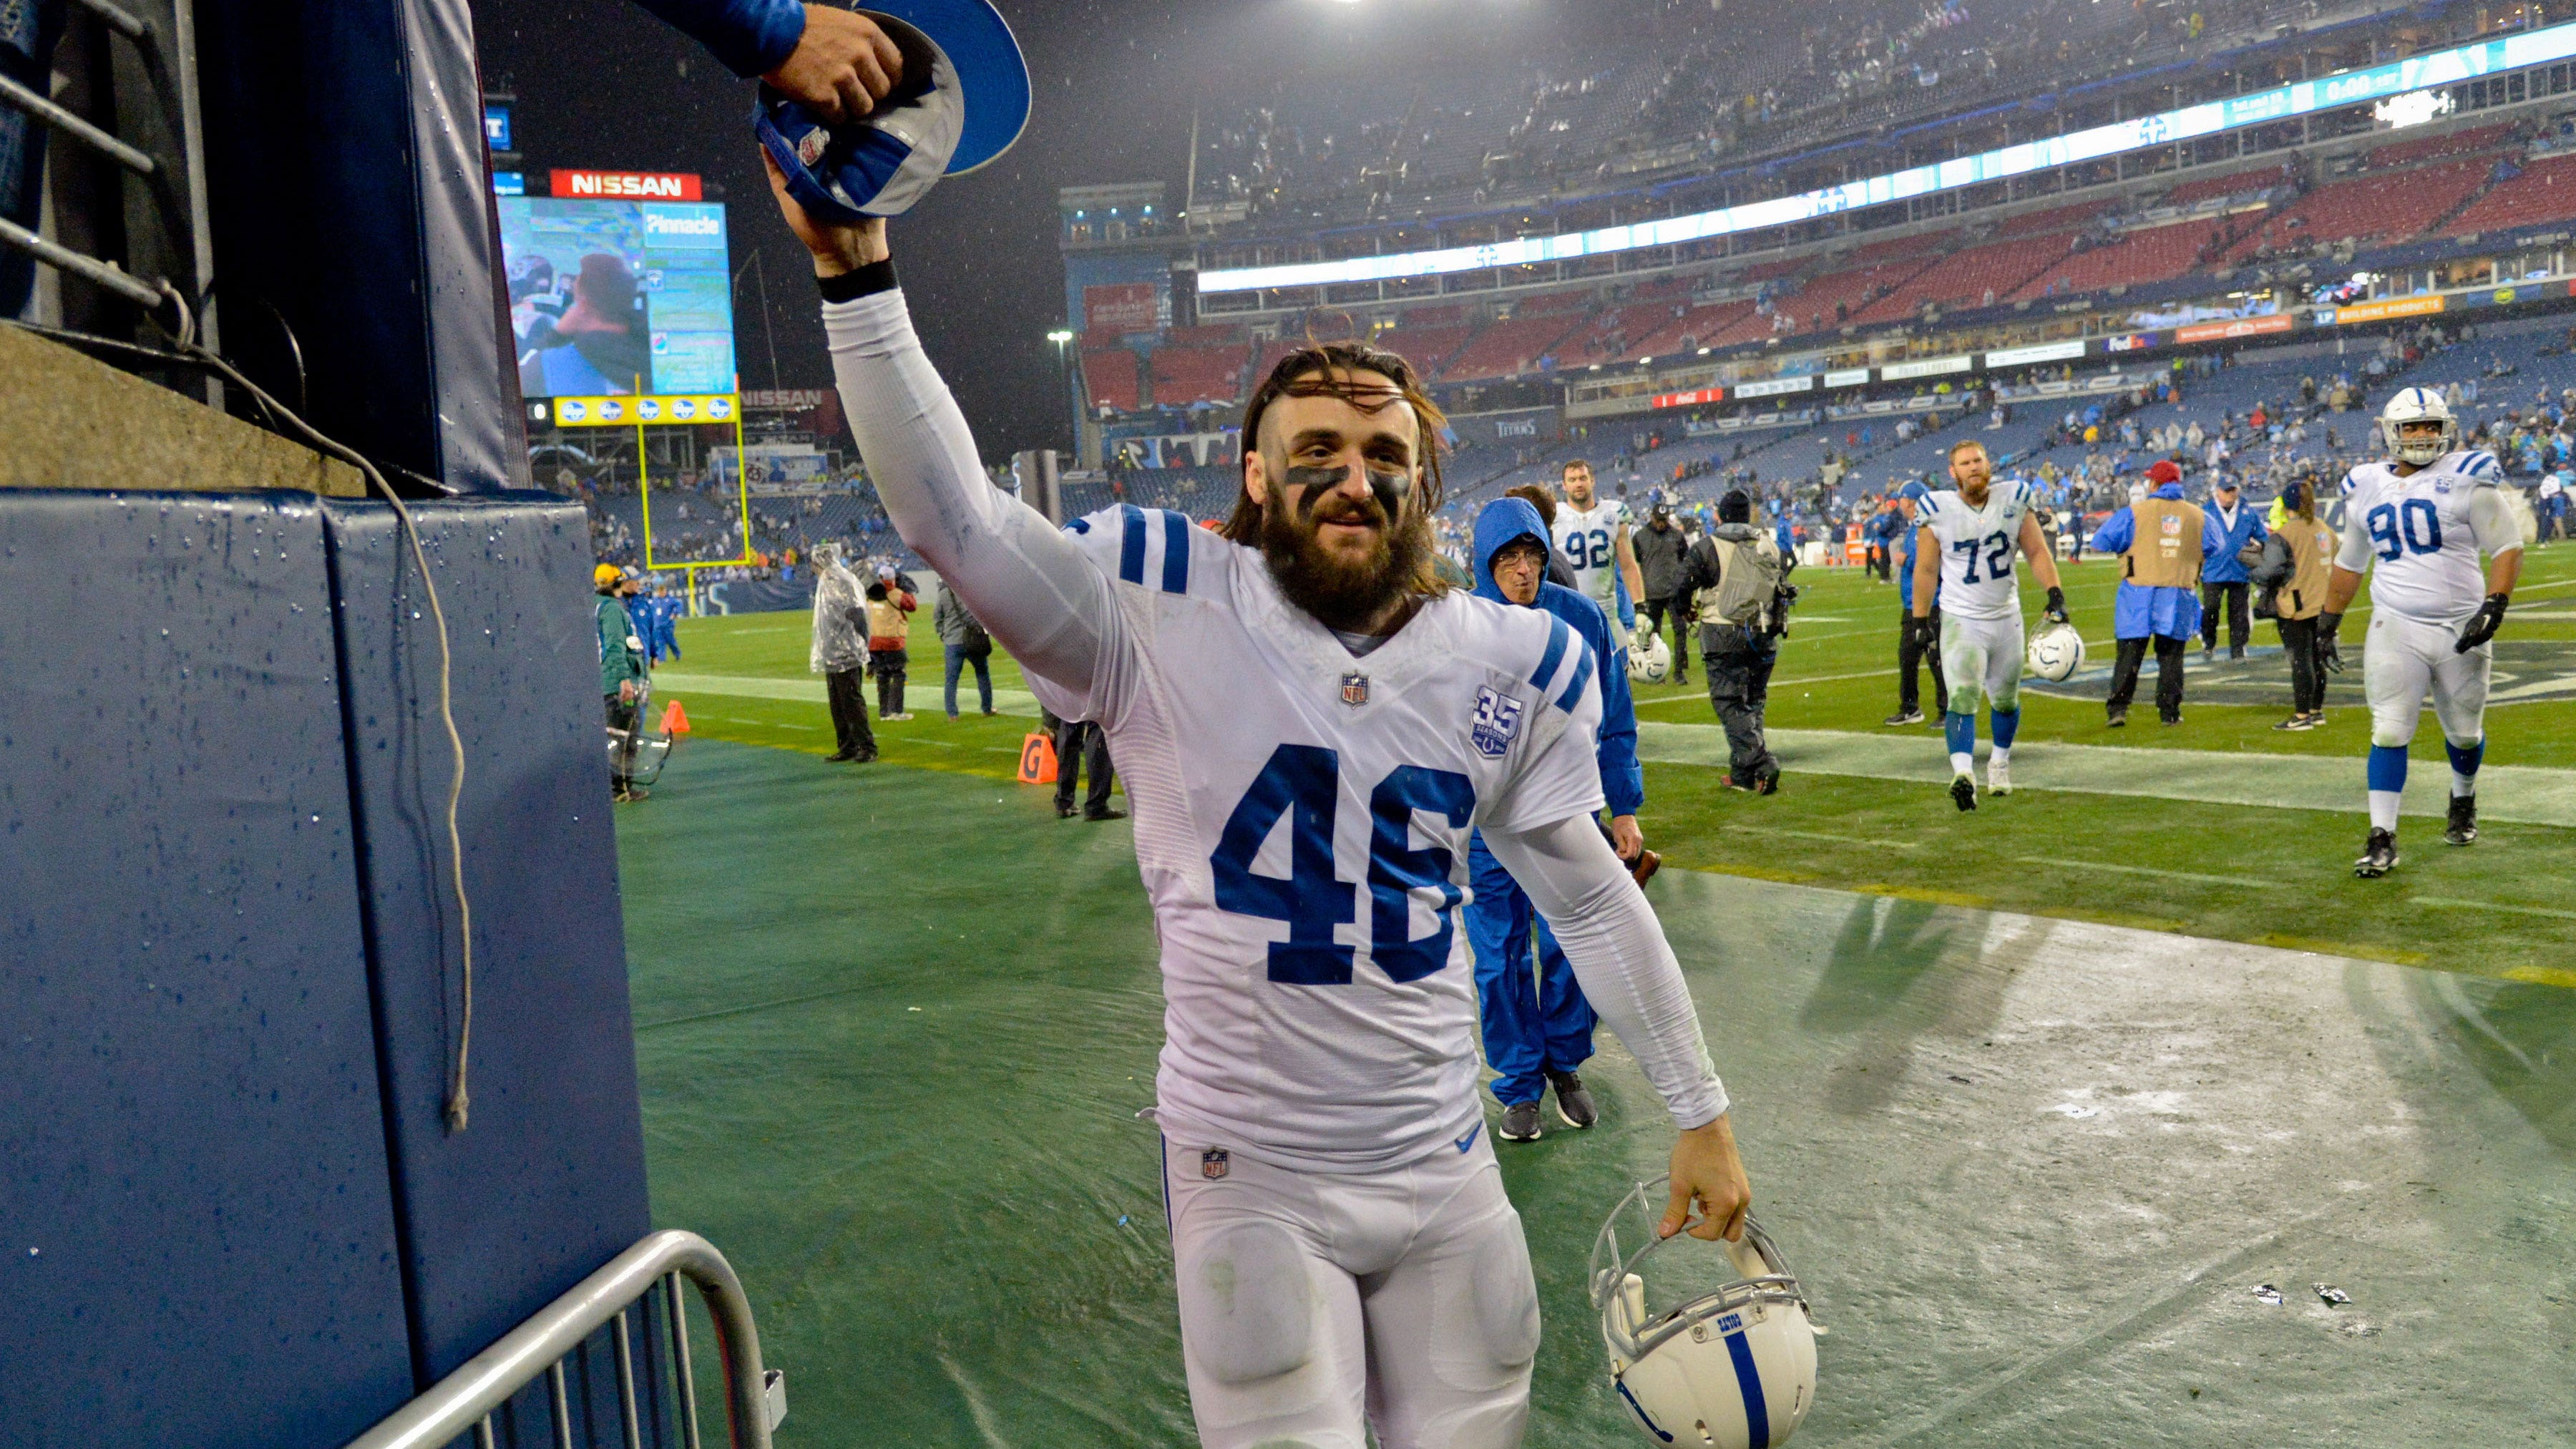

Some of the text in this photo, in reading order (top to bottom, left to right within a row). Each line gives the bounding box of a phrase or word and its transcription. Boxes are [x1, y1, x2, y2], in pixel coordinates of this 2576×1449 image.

[2327, 75, 2371, 102] 0:00
[572, 174, 682, 196] NISSAN
[646, 215, 719, 235] Pinnacle
[2338, 298, 2441, 321] BUILDING PRODUCTS
[739, 389, 822, 406] NISSAN
[2366, 498, 2443, 562] 90
[1565, 528, 1611, 570] 92
[1953, 530, 2011, 585] 72
[1343, 686, 1366, 701] NFL
[1473, 686, 1523, 739] 35
[1475, 724, 1508, 743] SEASONS
[1023, 739, 1043, 779] G
[1209, 742, 1476, 986] 46
[1204, 1161, 1226, 1176] NFL
[1717, 1312, 1742, 1333] COLTS
